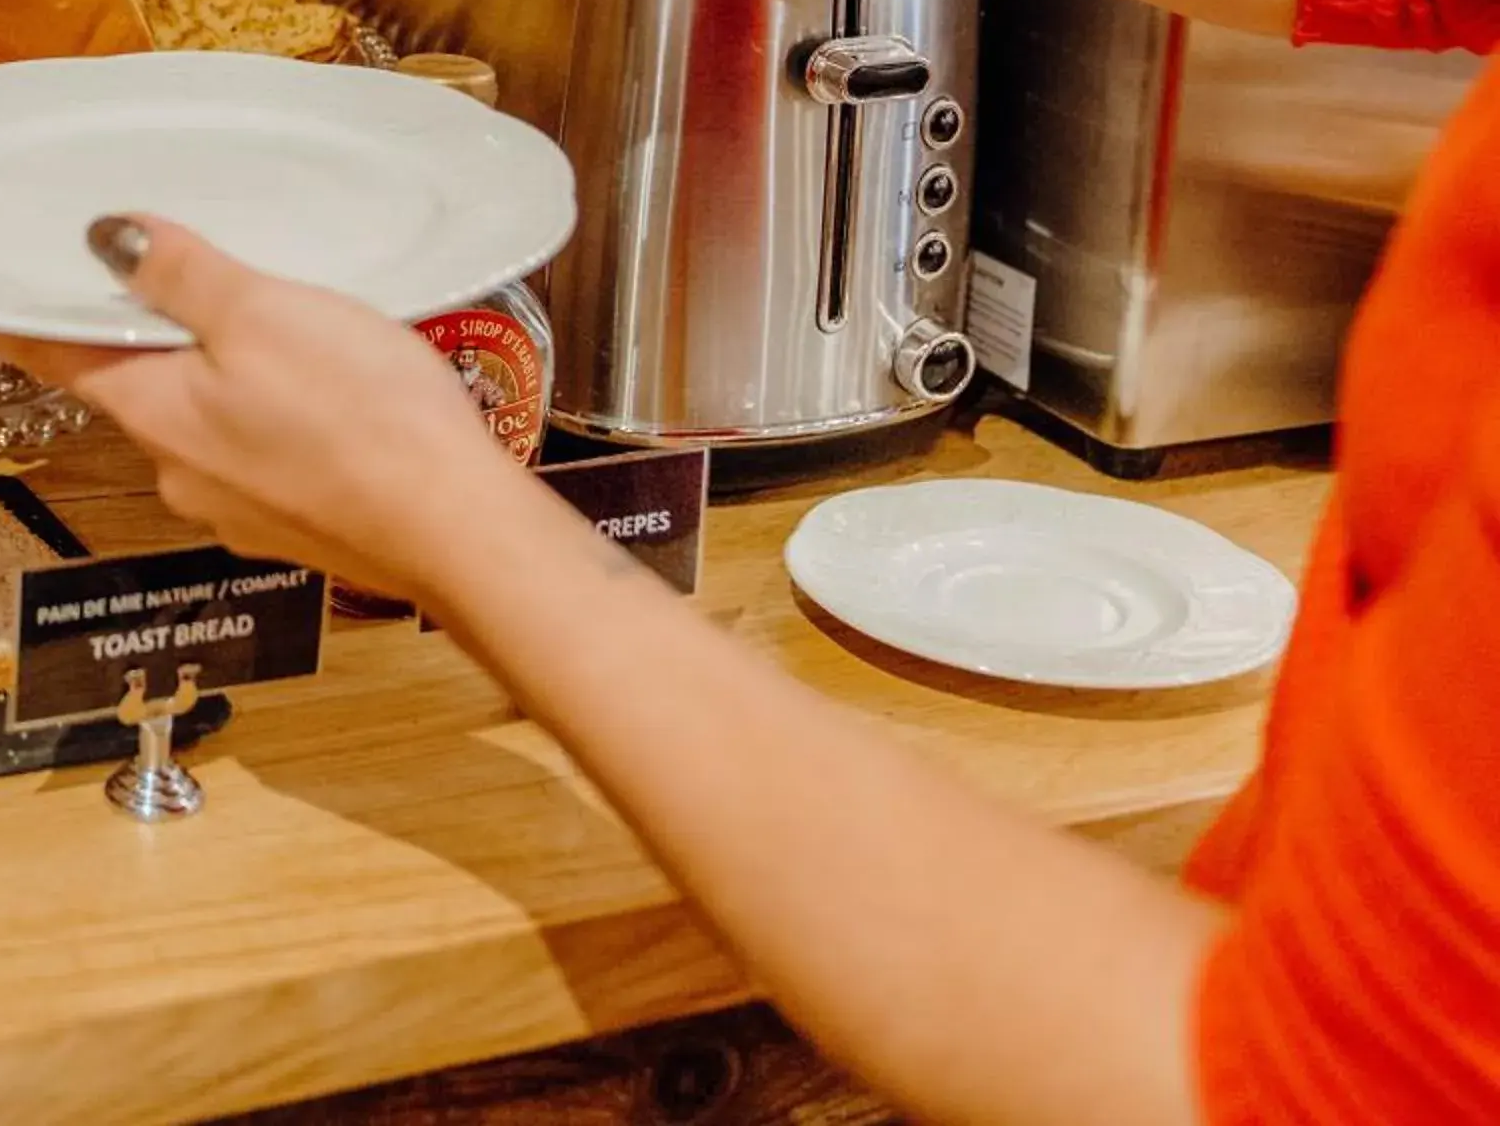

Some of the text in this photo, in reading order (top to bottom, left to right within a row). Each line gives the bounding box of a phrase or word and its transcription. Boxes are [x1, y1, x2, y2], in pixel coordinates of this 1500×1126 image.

[459, 319, 503, 339] SIROP
[595, 509, 672, 539] CREPES
[36, 568, 310, 626] PAIN DE MIE NATURE / COMPLET
[89, 613, 256, 661] TOAST BREAD
